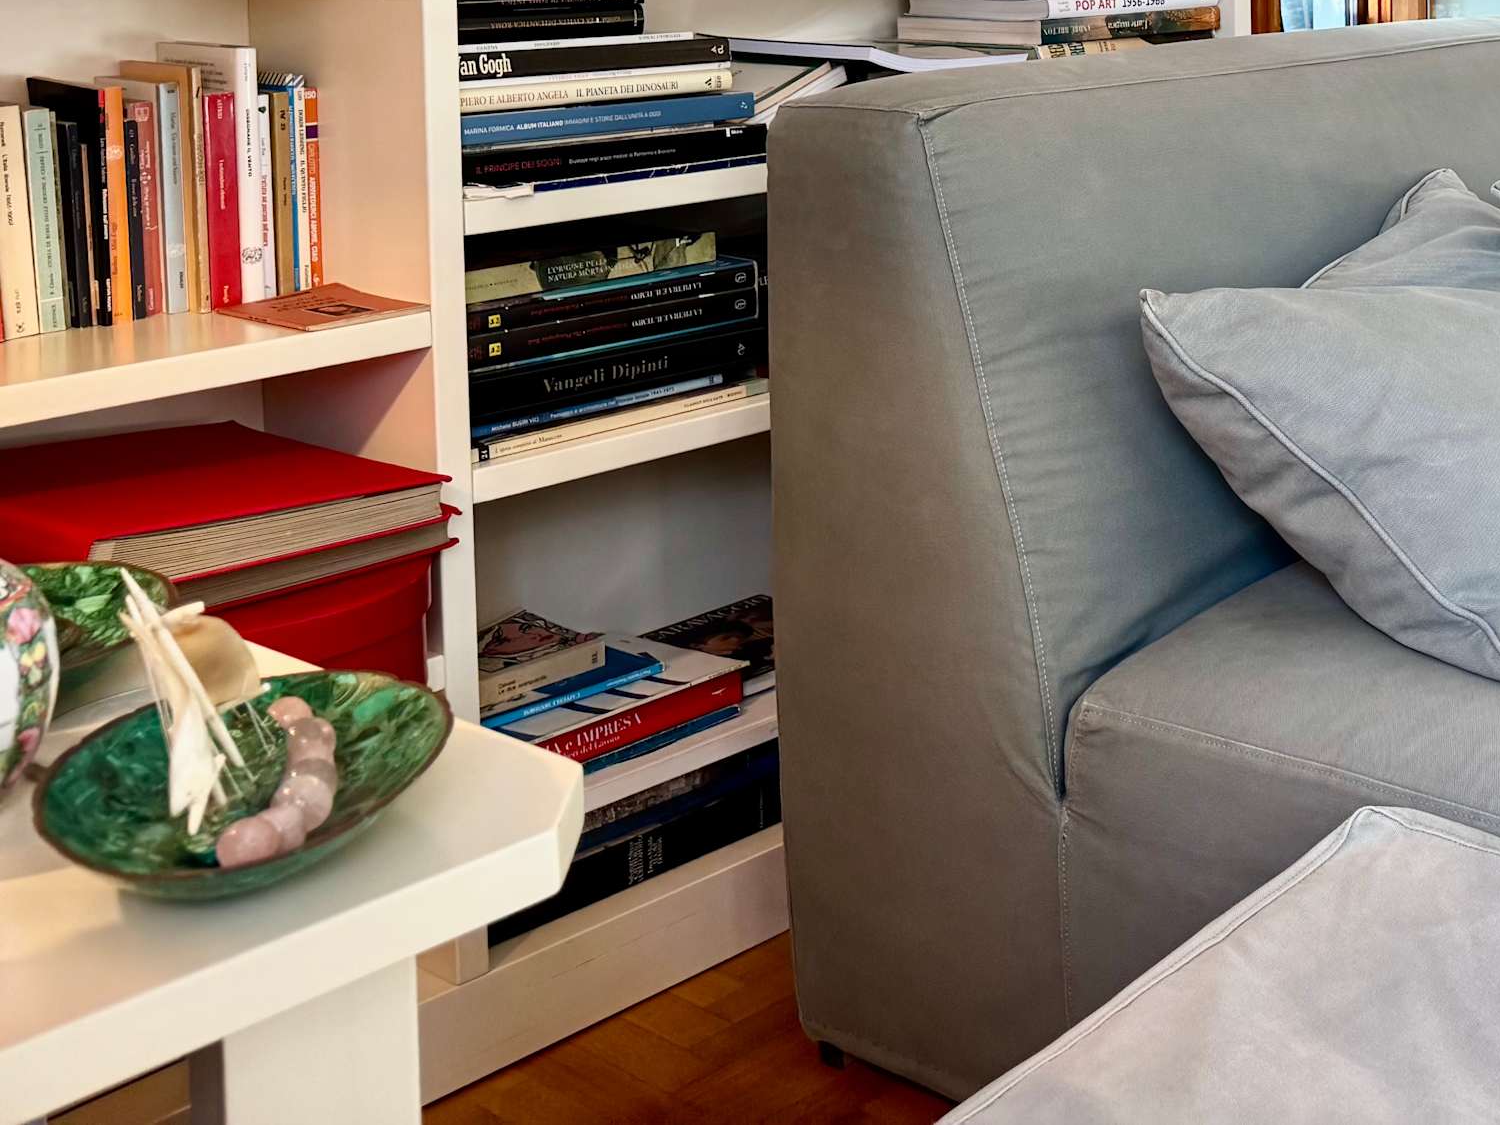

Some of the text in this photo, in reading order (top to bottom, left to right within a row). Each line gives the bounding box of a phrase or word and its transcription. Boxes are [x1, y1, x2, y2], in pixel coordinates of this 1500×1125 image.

[1075, 0, 1096, 11] POP
[1042, 24, 1091, 36] ANDRÉ BRETON
[1108, 20, 1130, 30] magica
[479, 53, 512, 76] Gogh
[304, 90, 316, 100] 150
[460, 81, 679, 107] PIERO E ALBERTO ANGELA IL PIANETA DEI DINOSAURI
[464, 127, 487, 136] MARINA
[488, 125, 515, 134] FORMICA
[516, 122, 536, 131] ALBUM
[537, 119, 564, 129] ITALIANO
[649, 110, 662, 118] OGGI
[297, 109, 308, 191] DORIS LESSING QUINTO
[484, 159, 562, 174] PRINCIPE DEI SOGNI
[547, 263, 584, 275] L'ORIGINE
[548, 267, 602, 282] NATURA MORTA
[669, 283, 692, 294] PIETRA
[692, 282, 702, 290] LA
[630, 291, 653, 301] TEMPO
[670, 310, 693, 321] PIETRA
[693, 308, 702, 317] LA
[631, 317, 654, 327] TEMPO
[543, 355, 669, 393] Vangeli Dipinti
[574, 711, 642, 749] IMPRESA
